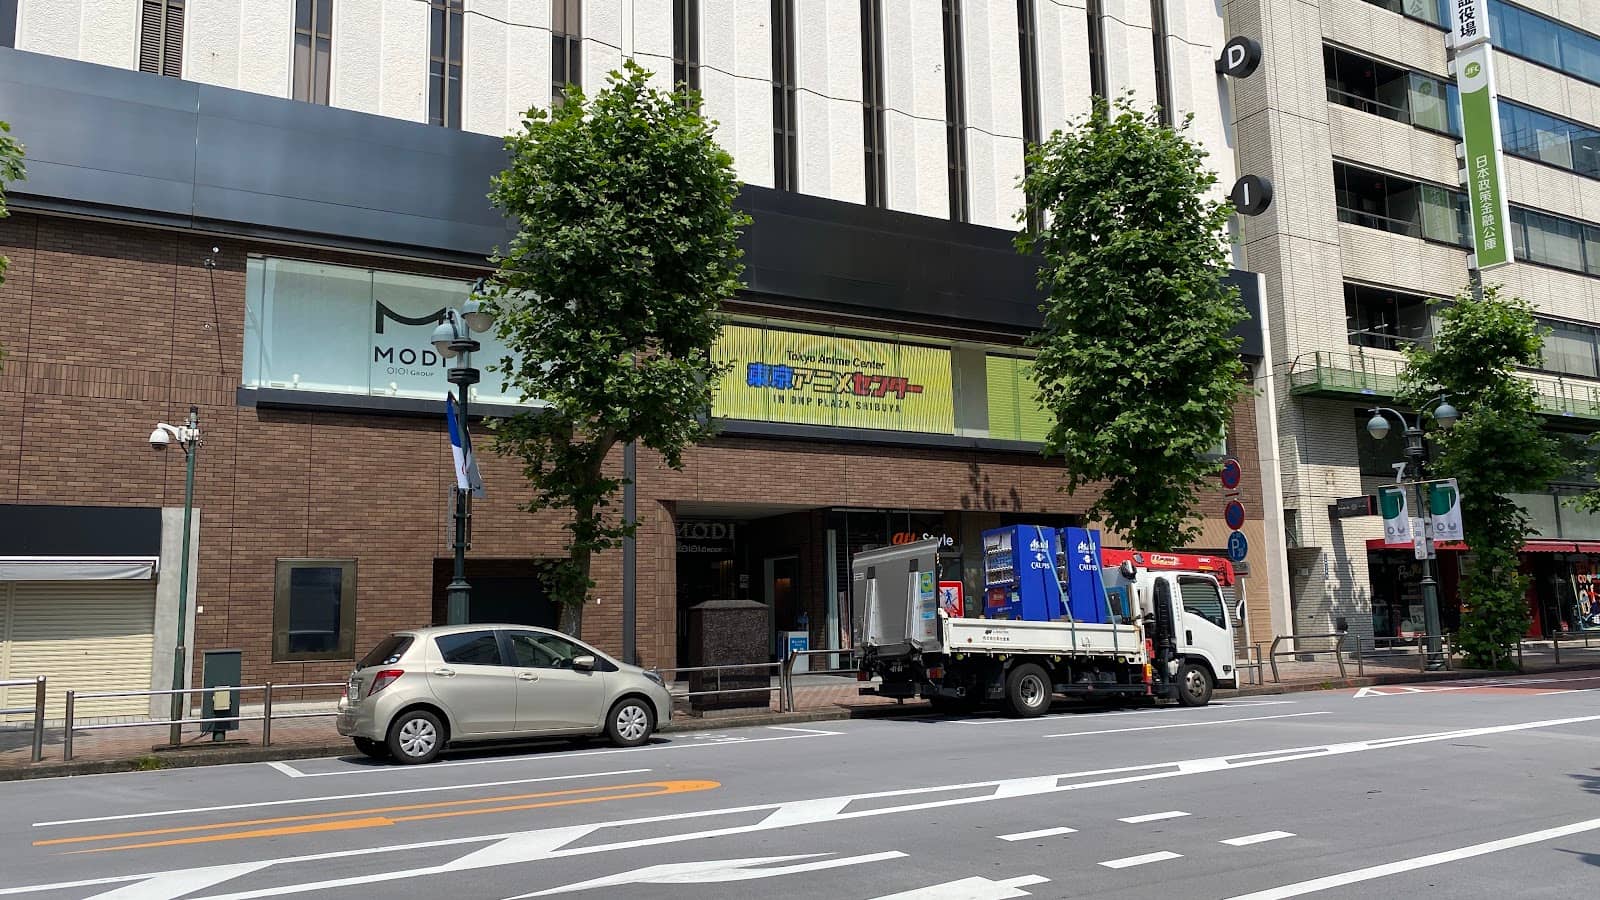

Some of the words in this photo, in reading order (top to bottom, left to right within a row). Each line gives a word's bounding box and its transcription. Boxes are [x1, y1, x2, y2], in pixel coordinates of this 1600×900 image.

[1227, 44, 1245, 69] D
[1475, 156, 1497, 251] 日本政策金融公庫
[787, 350, 816, 366] Tokyo
[818, 354, 851, 367] Anime
[852, 357, 885, 370] Center
[747, 362, 923, 399] 東京アニメセンター
[773, 394, 785, 404] IN
[818, 398, 850, 409] PLAZA
[855, 401, 901, 413] SHIBUYA
[1391, 462, 1409, 483] 7
